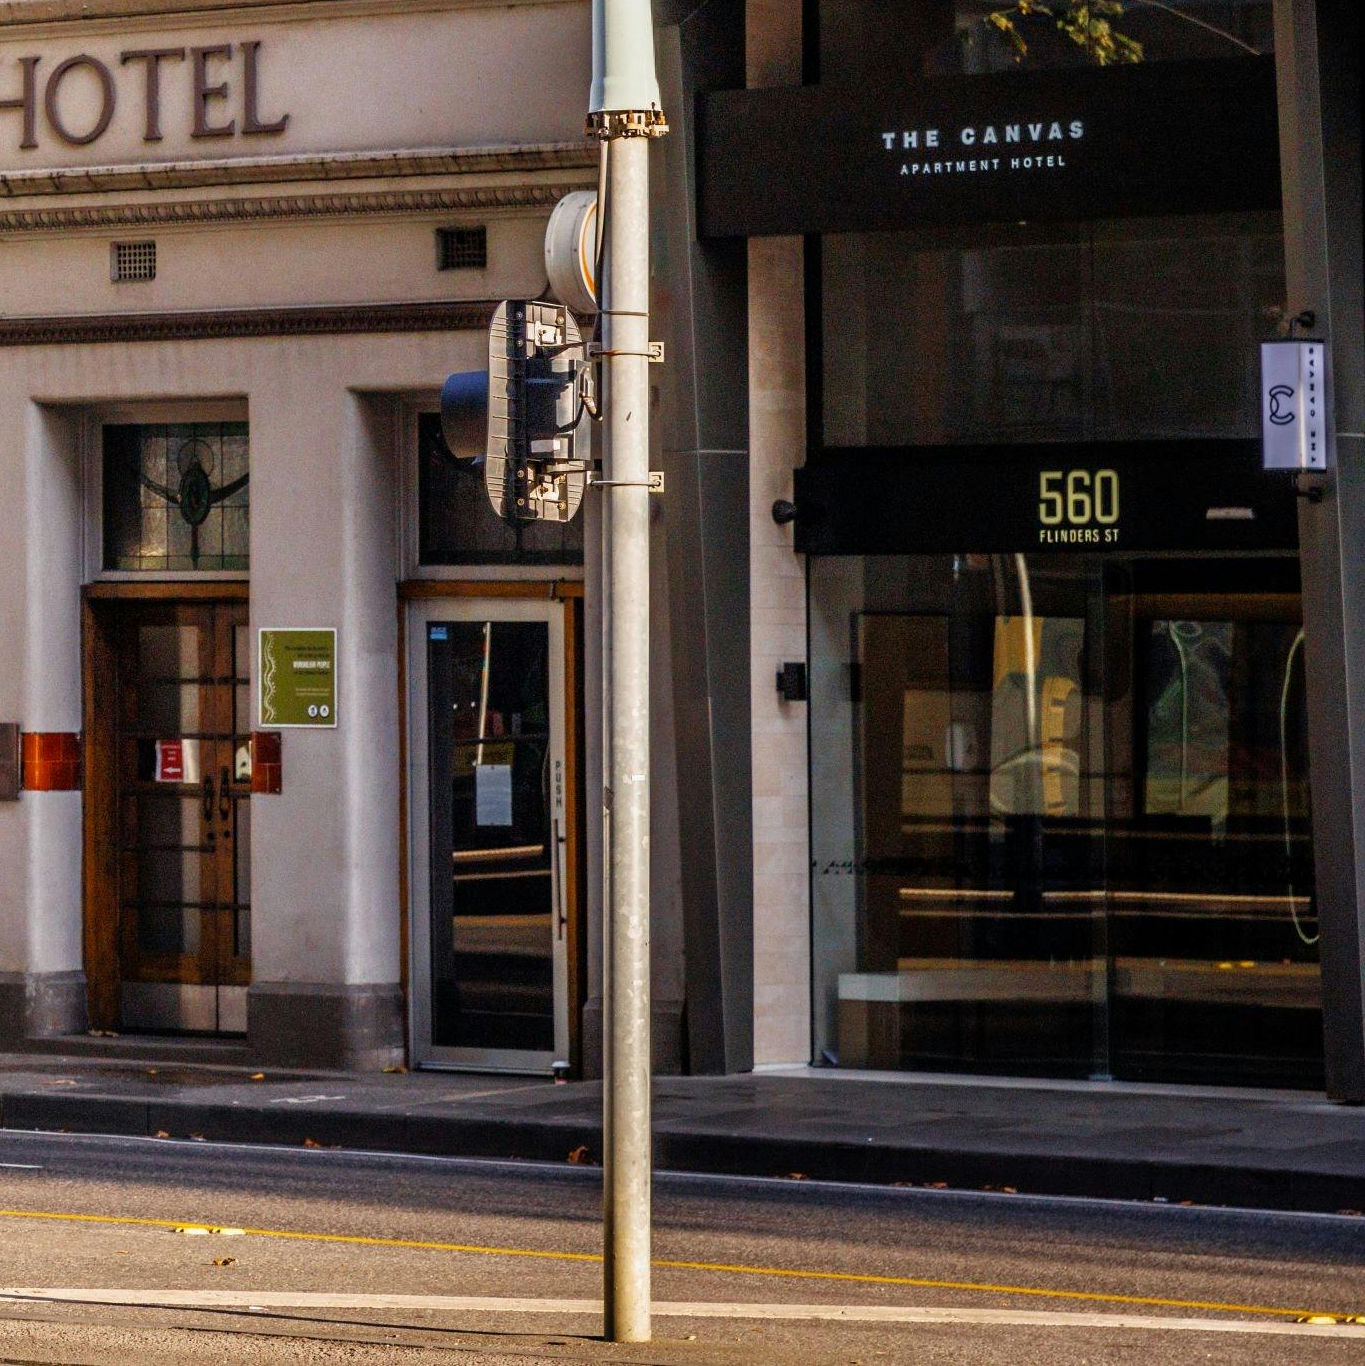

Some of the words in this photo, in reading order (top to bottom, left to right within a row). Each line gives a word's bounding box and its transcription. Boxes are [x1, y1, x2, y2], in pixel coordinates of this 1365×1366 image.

[882, 130, 940, 150] THE
[961, 120, 1085, 145] CANVAS
[900, 158, 1000, 176] APARTMENT
[1011, 155, 1066, 169] HOTEL
[1039, 468, 1120, 525] 560
[1039, 528, 1100, 544] FLINDERS
[1104, 528, 1120, 543] ST
